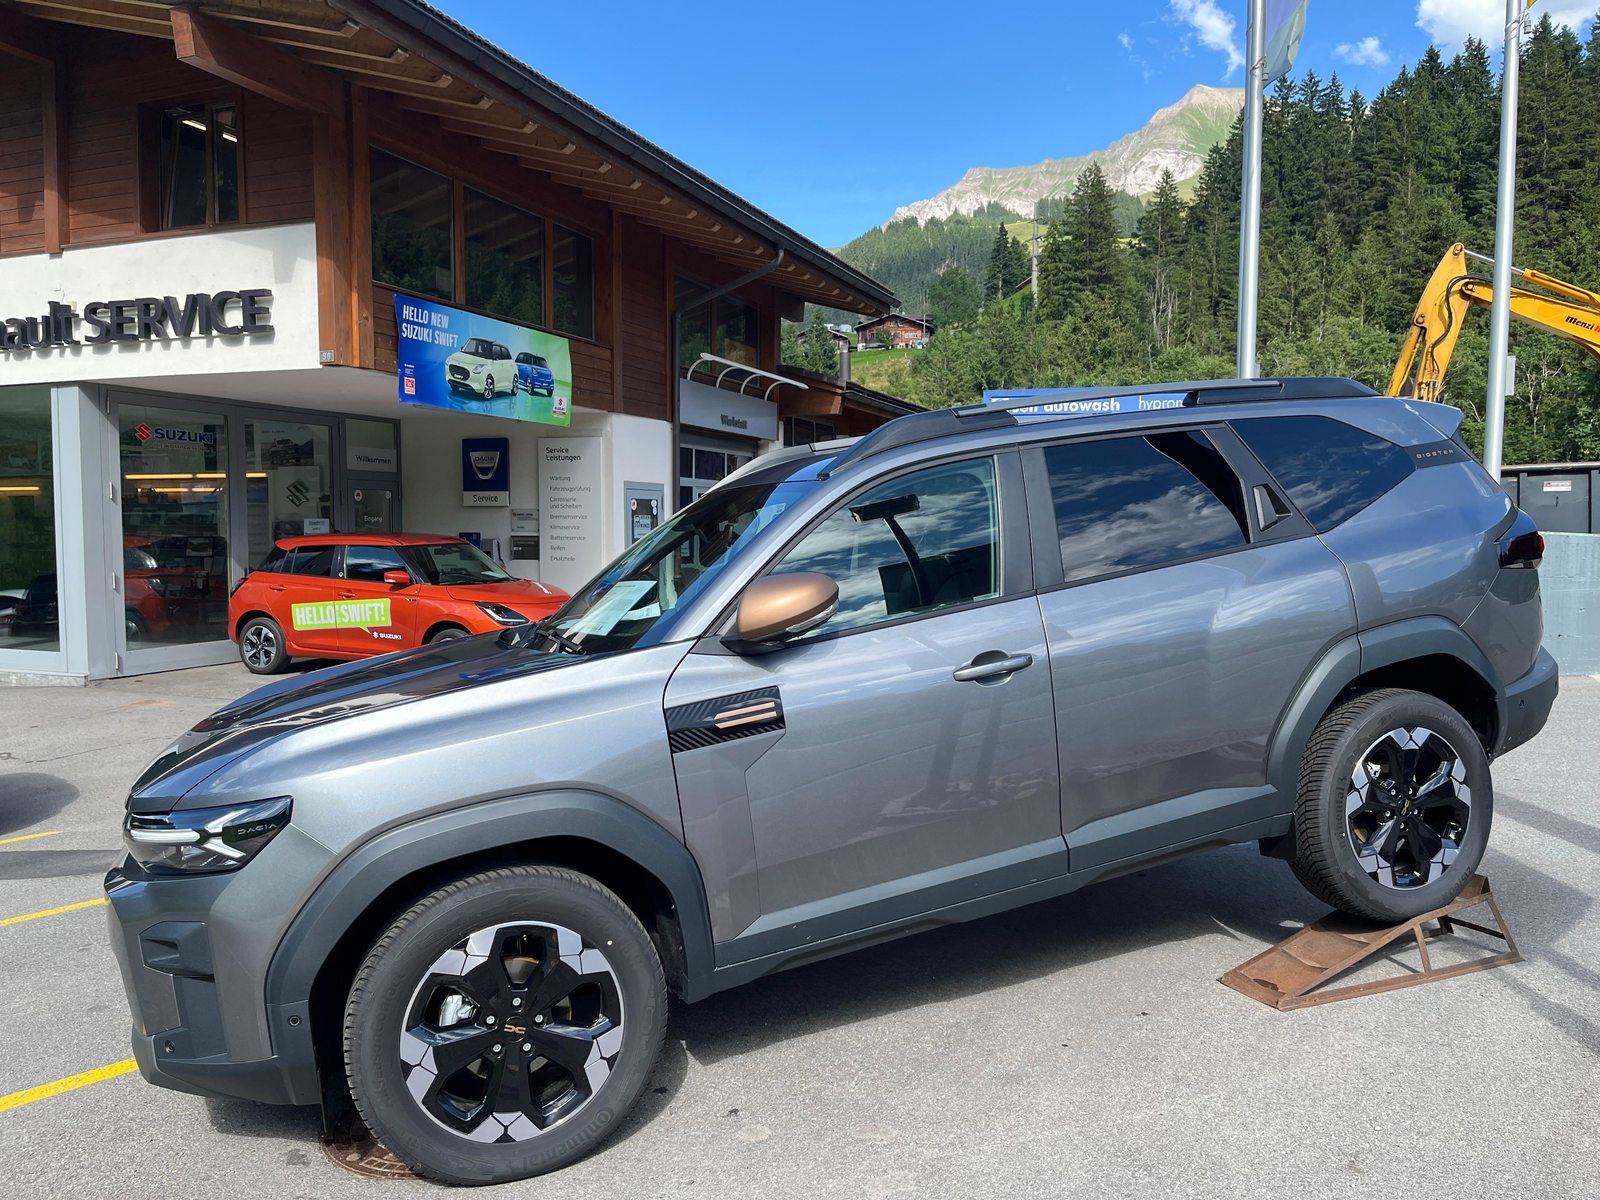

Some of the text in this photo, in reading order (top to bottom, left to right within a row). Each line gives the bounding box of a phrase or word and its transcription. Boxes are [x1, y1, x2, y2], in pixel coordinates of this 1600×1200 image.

[84, 288, 275, 344] SERVICE
[402, 304, 449, 329] HELLO NEW
[401, 322, 459, 348] SUZUKI SWIFT
[1043, 397, 1120, 413] autowash
[154, 427, 214, 444] SUZUKI
[545, 446, 569, 454] Service
[1416, 449, 1454, 459] BIGSTER
[355, 455, 392, 465] Willkommen
[545, 454, 581, 462] Leistungen
[473, 494, 499, 503] Service
[237, 823, 278, 836] DACIA
